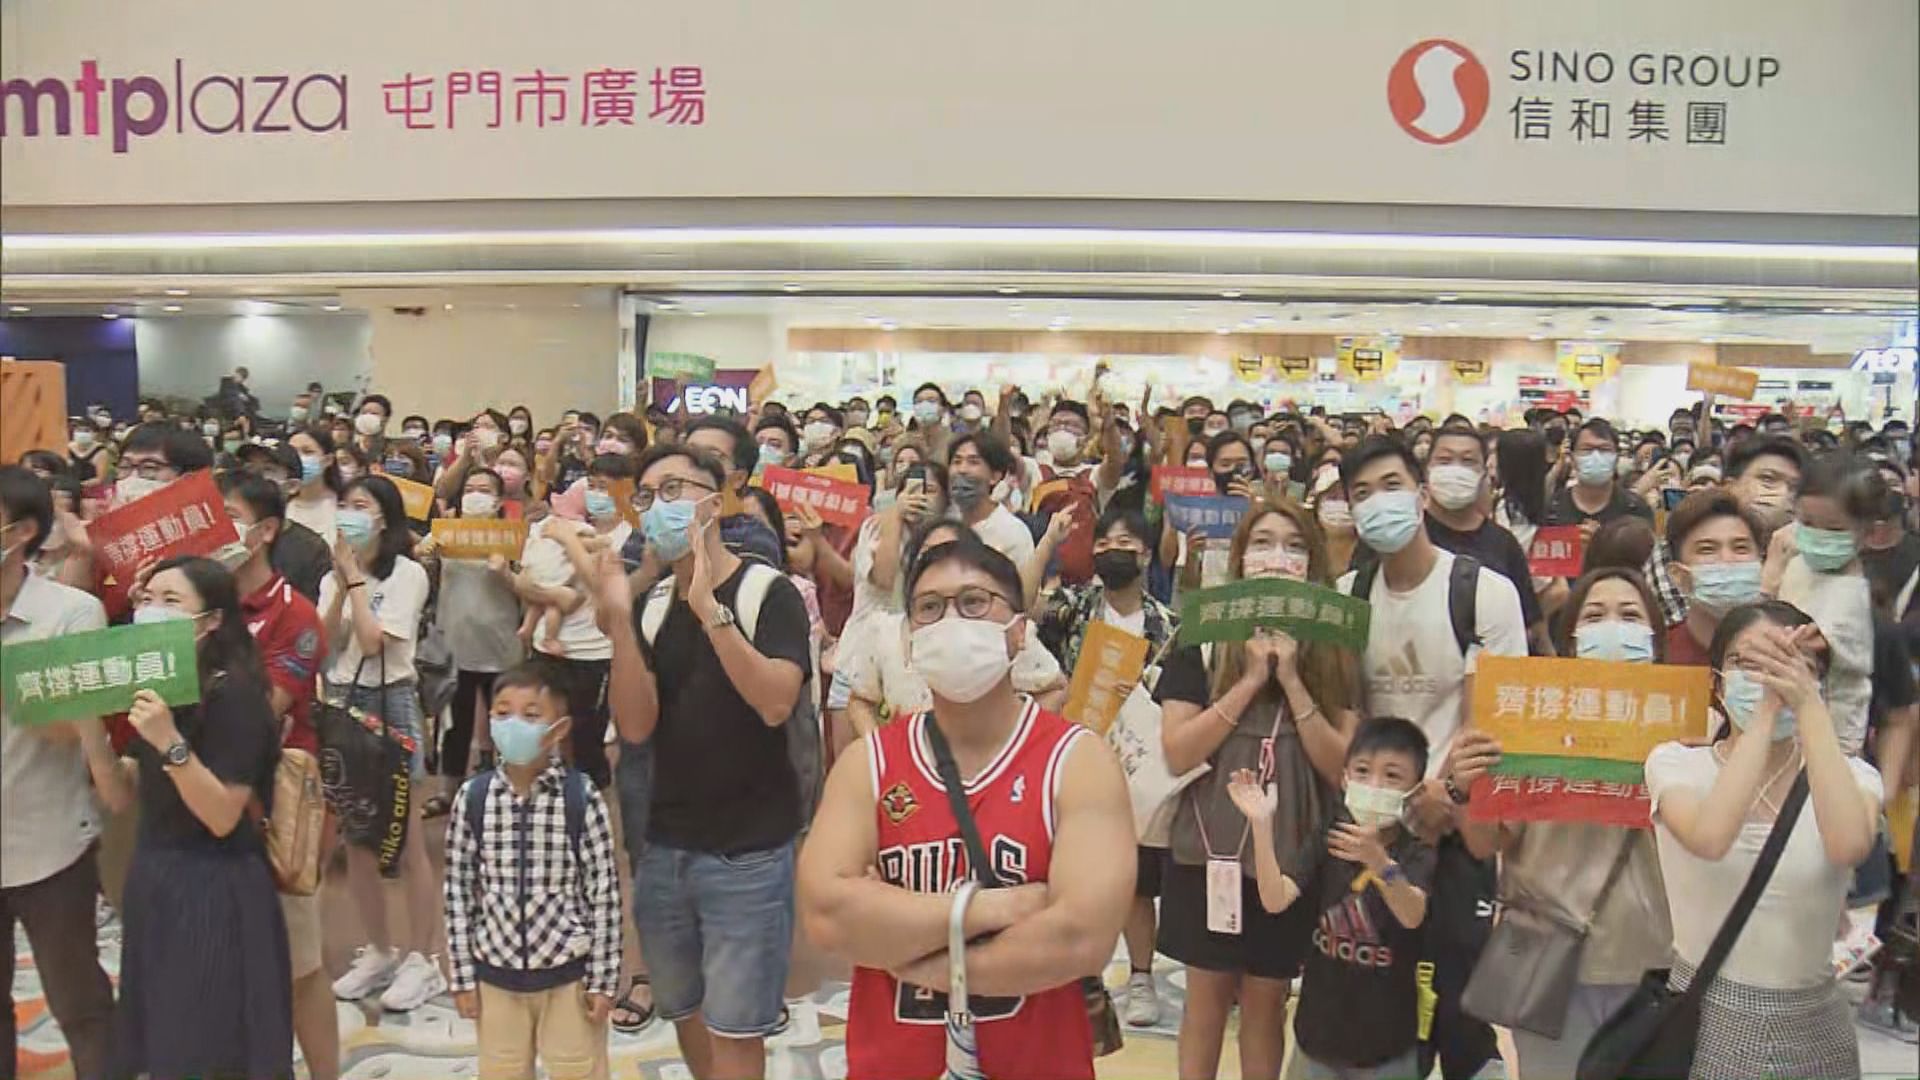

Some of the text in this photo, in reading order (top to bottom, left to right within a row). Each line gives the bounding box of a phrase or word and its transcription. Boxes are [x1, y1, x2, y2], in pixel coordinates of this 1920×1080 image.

[1509, 49, 1780, 88] SINO GROUP
[381, 66, 706, 130] 屯門市廣場
[1509, 96, 1727, 144] 信和集團
[1492, 684, 1687, 727] 齊撐運動員!
[878, 833, 1028, 895] BULS
